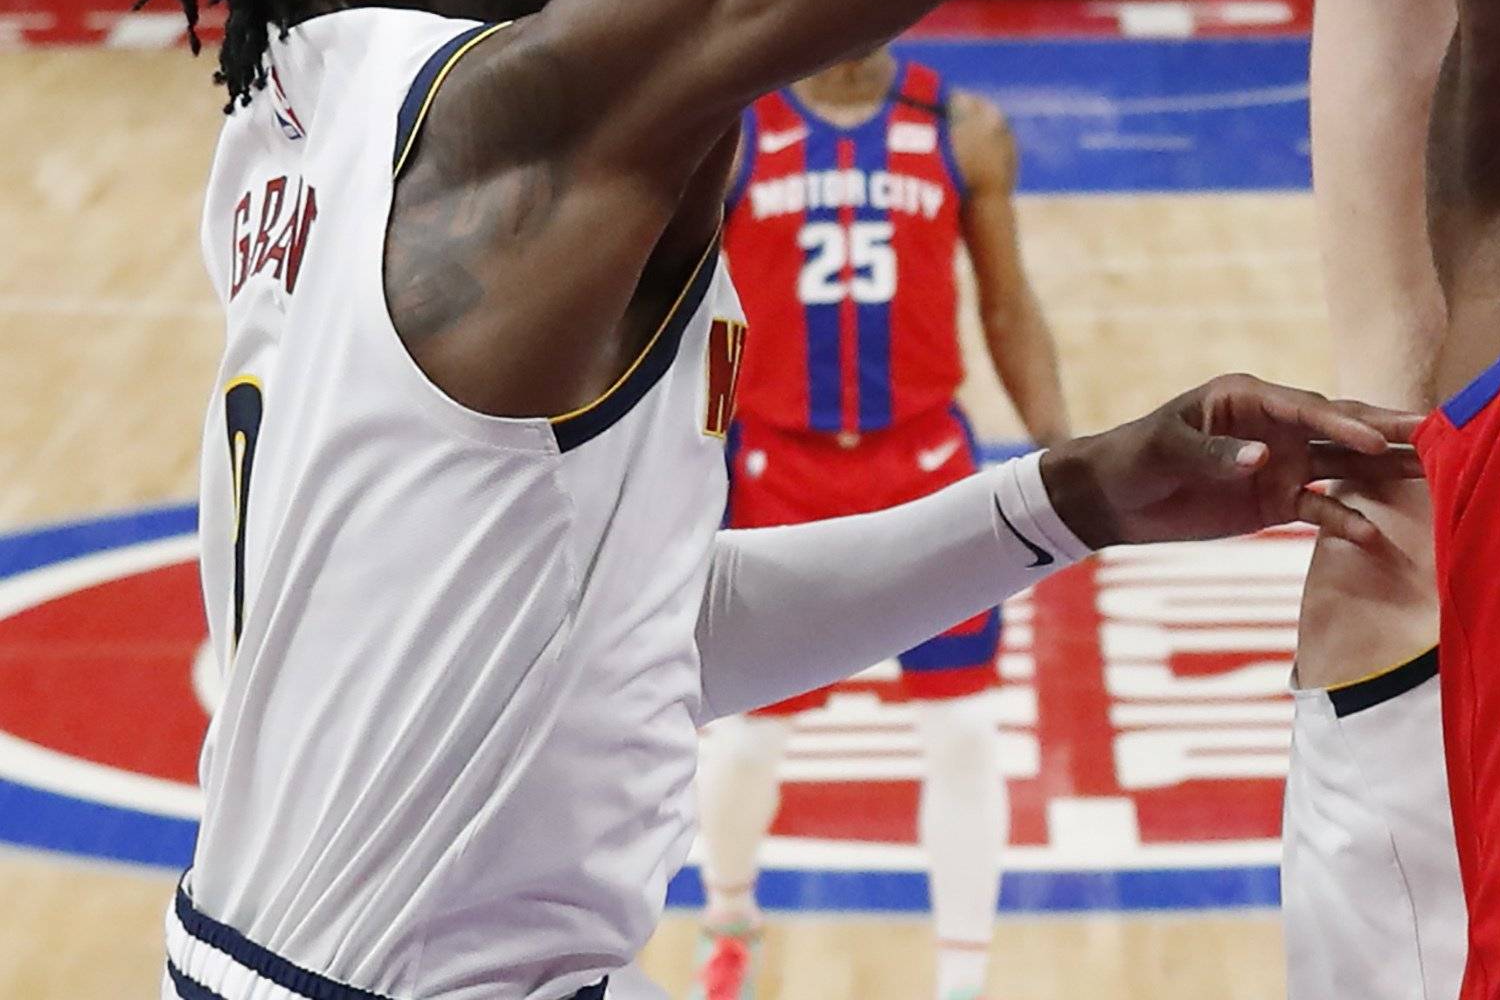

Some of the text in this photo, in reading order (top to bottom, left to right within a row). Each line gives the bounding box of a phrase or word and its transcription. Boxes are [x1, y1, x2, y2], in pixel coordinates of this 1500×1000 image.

[751, 168, 945, 221] MOTOR CITY
[228, 173, 318, 302] GRAN
[798, 221, 897, 305] 25
